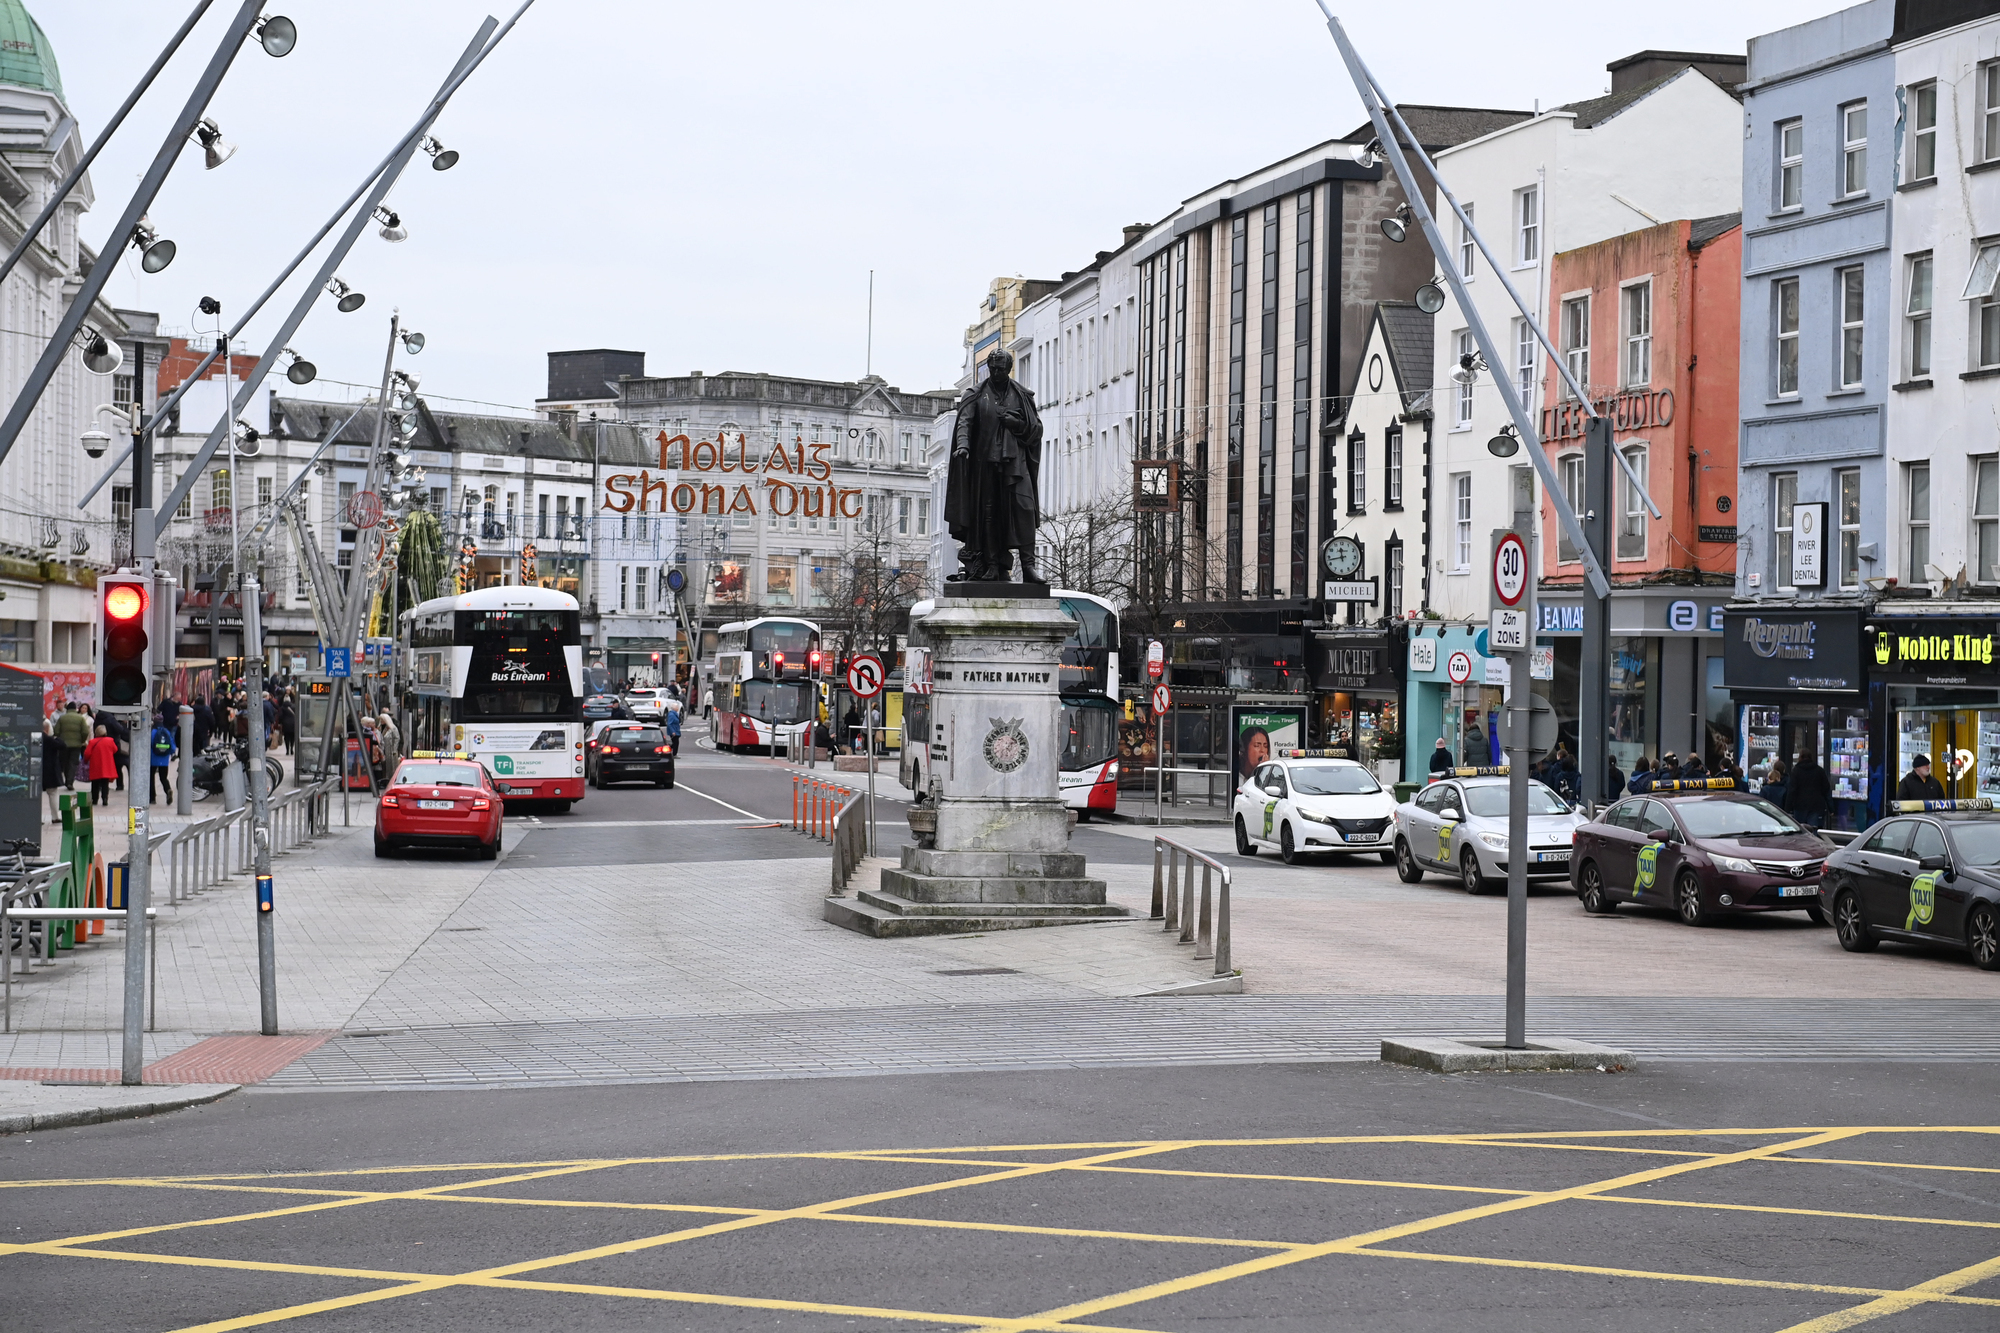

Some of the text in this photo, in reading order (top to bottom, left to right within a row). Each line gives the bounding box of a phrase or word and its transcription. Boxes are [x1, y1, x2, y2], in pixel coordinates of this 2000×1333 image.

[600, 469, 758, 516] Shona
[1797, 540, 1816, 551] RIVER
[1502, 547, 1519, 577] 30
[1800, 554, 1812, 566] LEE
[1794, 569, 1818, 581] DENTAL
[1504, 579, 1516, 590] km/h
[1328, 586, 1372, 596] MICHEL
[1502, 612, 1517, 625] Zón
[1497, 630, 1520, 644] ZONE
[1742, 618, 1812, 658] Regent
[1413, 645, 1432, 665] Hale
[1898, 634, 1993, 664] Mobile King
[1328, 648, 1376, 674] MICHEL
[1452, 663, 1467, 672] TAXI
[491, 671, 545, 682] Bus Éireann
[963, 671, 1002, 682] FATHER
[1006, 671, 1050, 683] MATHEW
[1240, 716, 1269, 726] Tired
[985, 726, 1008, 764] TEMPERANCE
[1016, 732, 1026, 746] THE
[1305, 749, 1323, 757] TAXI
[496, 761, 512, 770] TFI
[1006, 749, 1026, 770] APSTLE
[1477, 766, 1497, 774] TAXI
[1683, 778, 1733, 789] TAXI 10918
[1928, 800, 1952, 810] TAXI
[1964, 799, 1990, 809] 33074
[1349, 834, 1377, 842] 222-C-6024
[1440, 837, 1450, 850] TAXI
[1639, 858, 1654, 874] TAXI
[1914, 889, 1932, 906] TAXI
